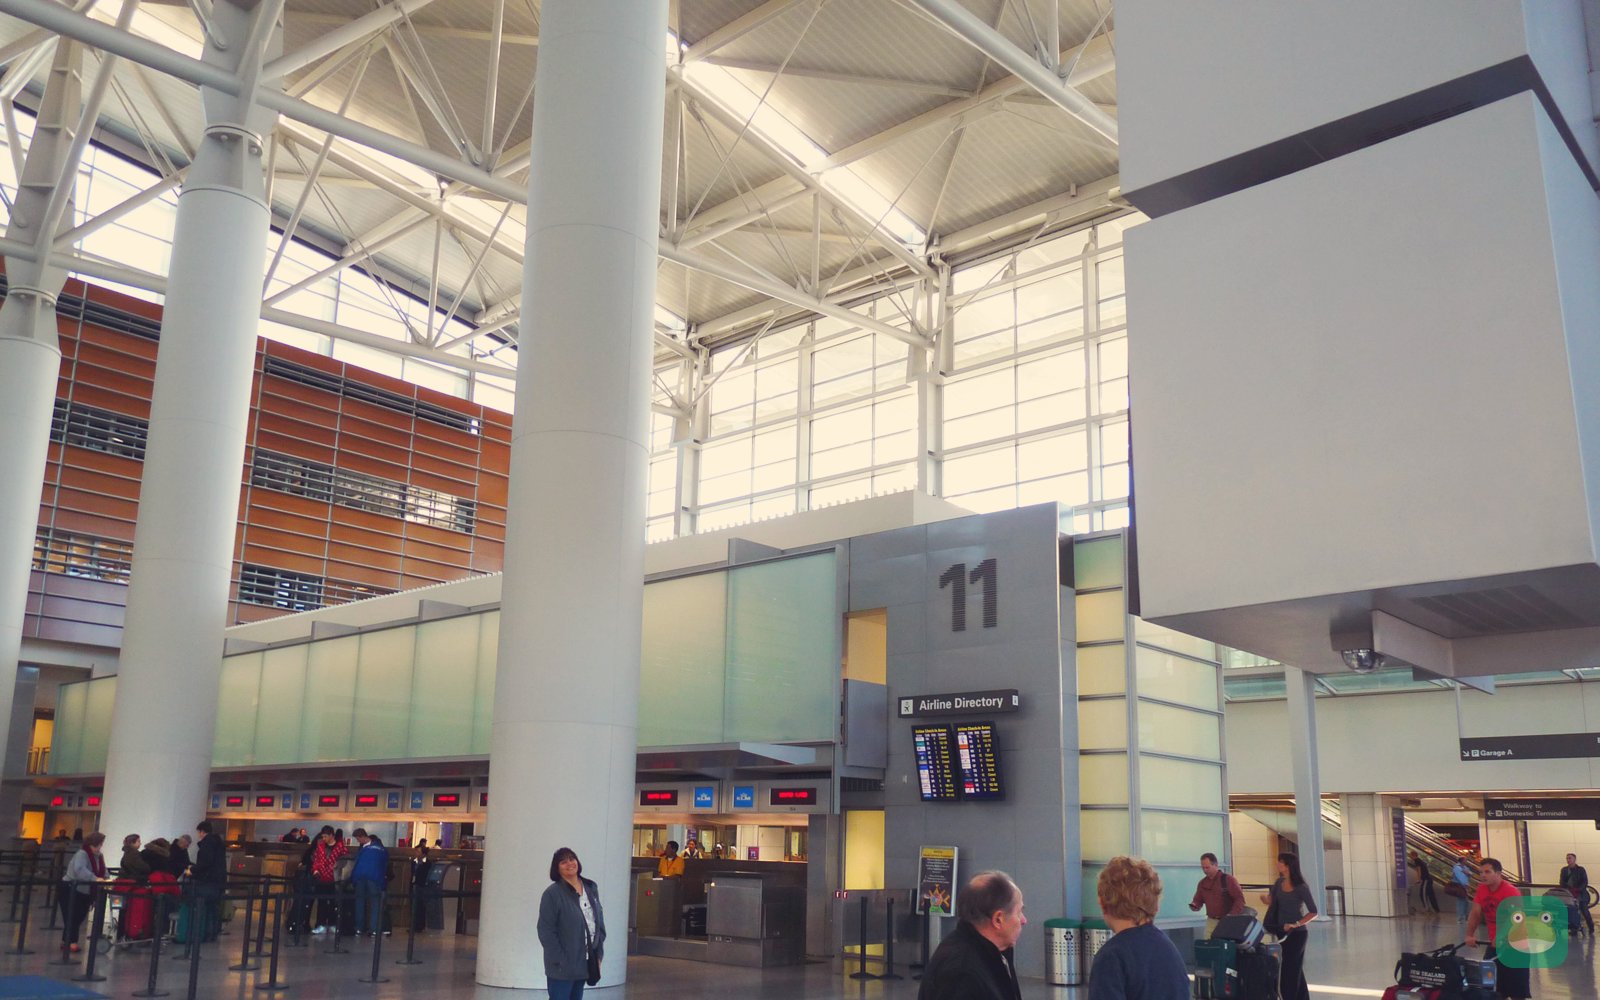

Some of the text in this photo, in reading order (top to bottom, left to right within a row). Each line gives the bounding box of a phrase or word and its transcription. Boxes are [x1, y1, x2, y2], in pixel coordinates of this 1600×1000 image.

[938, 558, 997, 632] 11
[919, 697, 1003, 711] Airline Directory
